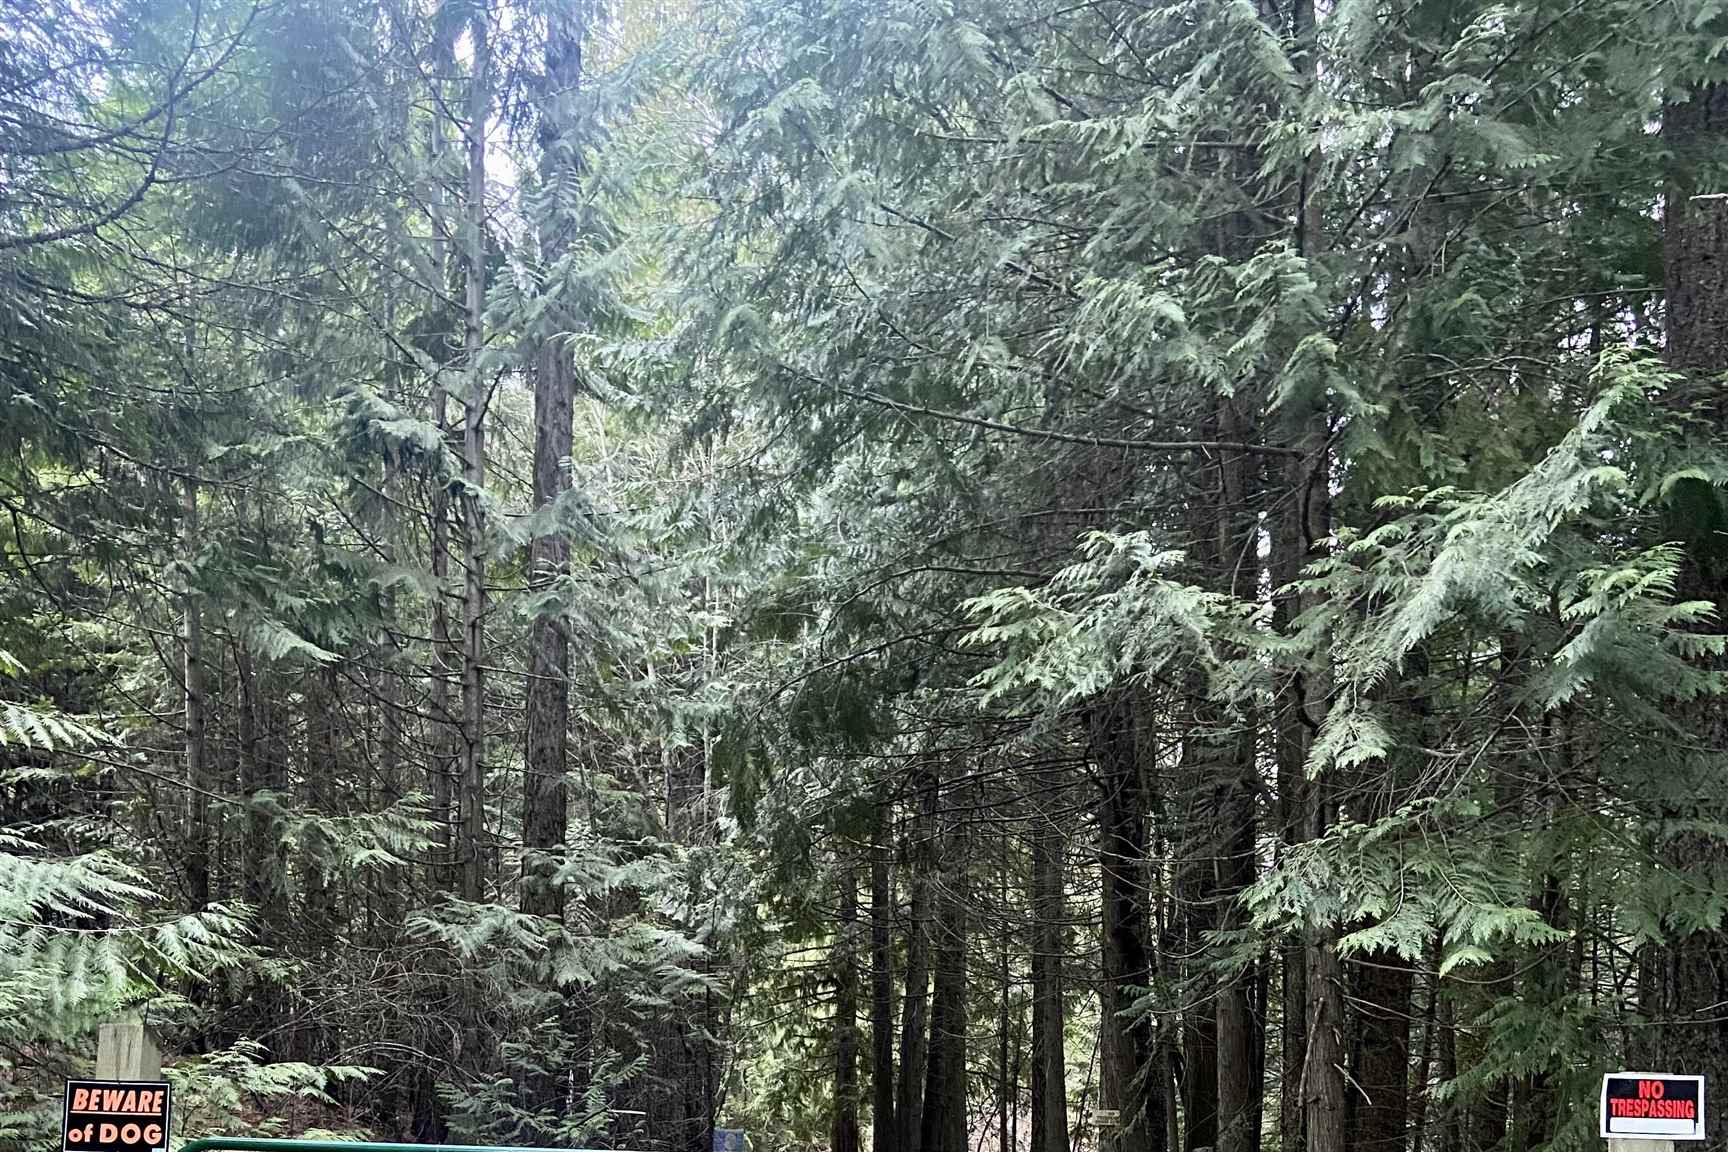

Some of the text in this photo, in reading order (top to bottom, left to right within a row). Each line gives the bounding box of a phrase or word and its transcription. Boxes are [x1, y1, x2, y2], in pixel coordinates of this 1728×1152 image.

[1638, 1080, 1665, 1099] NO
[72, 1088, 165, 1113] BEWARE
[1609, 1098, 1695, 1118] TRESPASSING
[68, 1123, 162, 1145] of DOG
